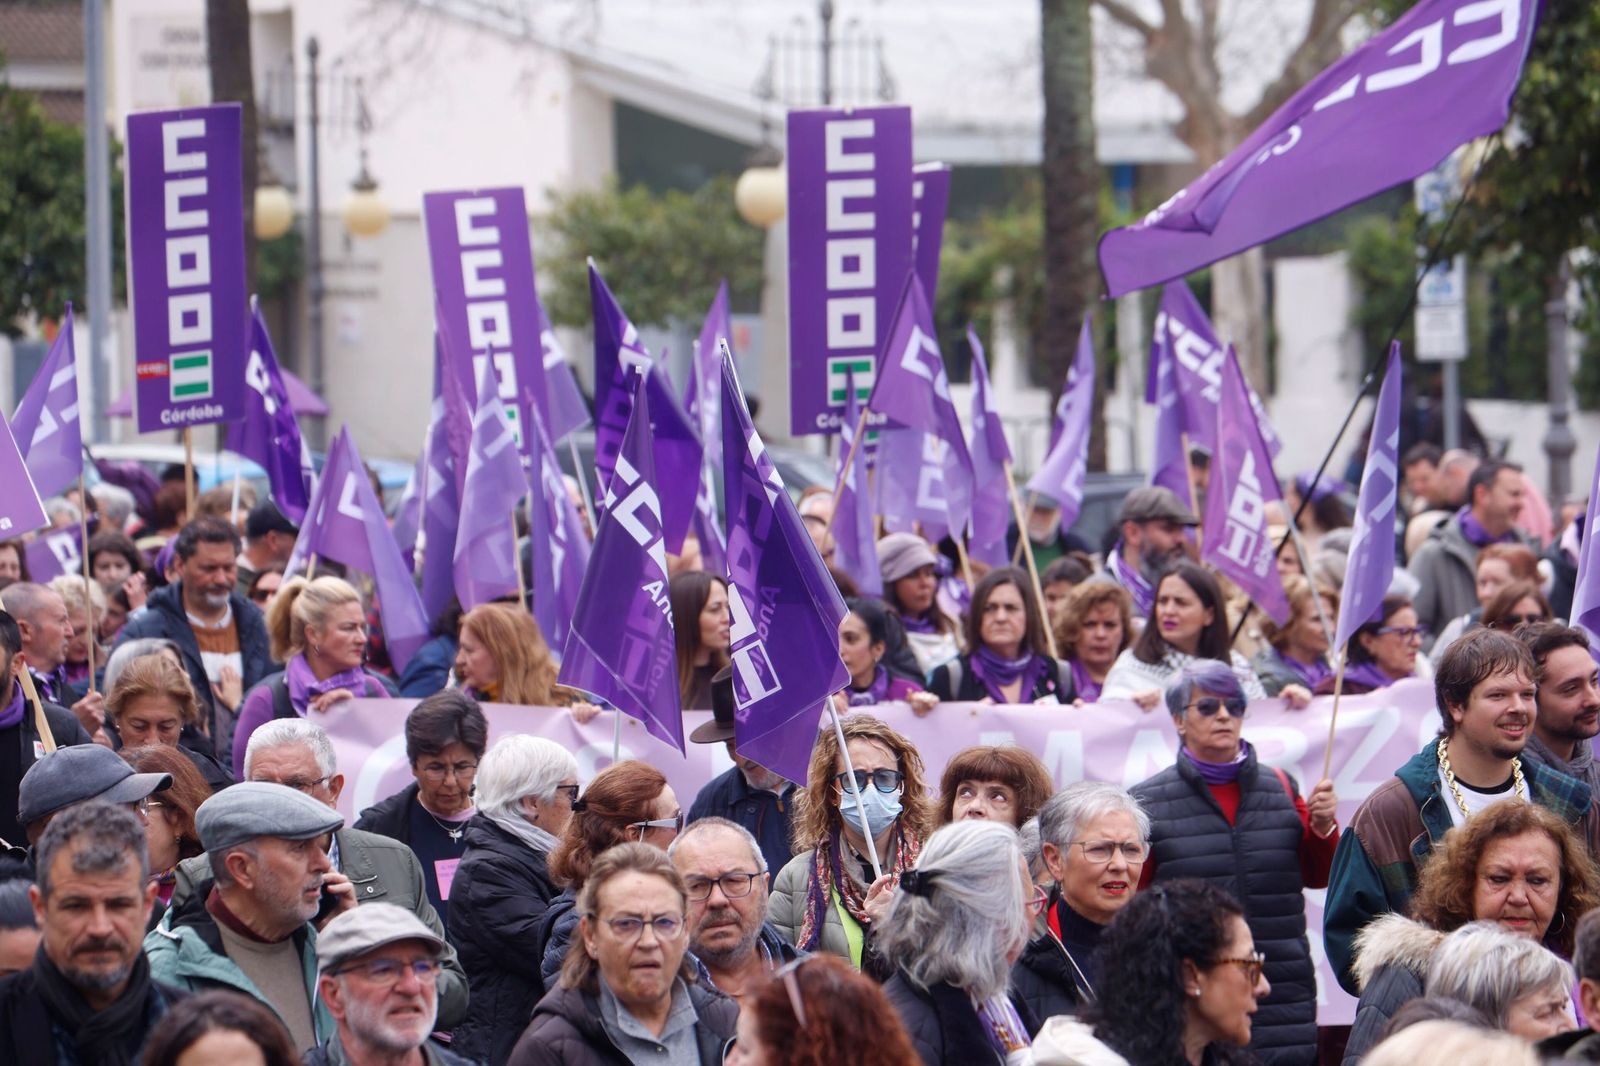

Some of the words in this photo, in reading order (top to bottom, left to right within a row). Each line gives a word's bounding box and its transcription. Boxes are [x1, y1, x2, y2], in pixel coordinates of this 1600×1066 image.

[162, 119, 212, 346] CCOO
[825, 119, 876, 349] CCOO
[161, 404, 224, 424] Córdoba
[816, 412, 888, 428] Cóba
